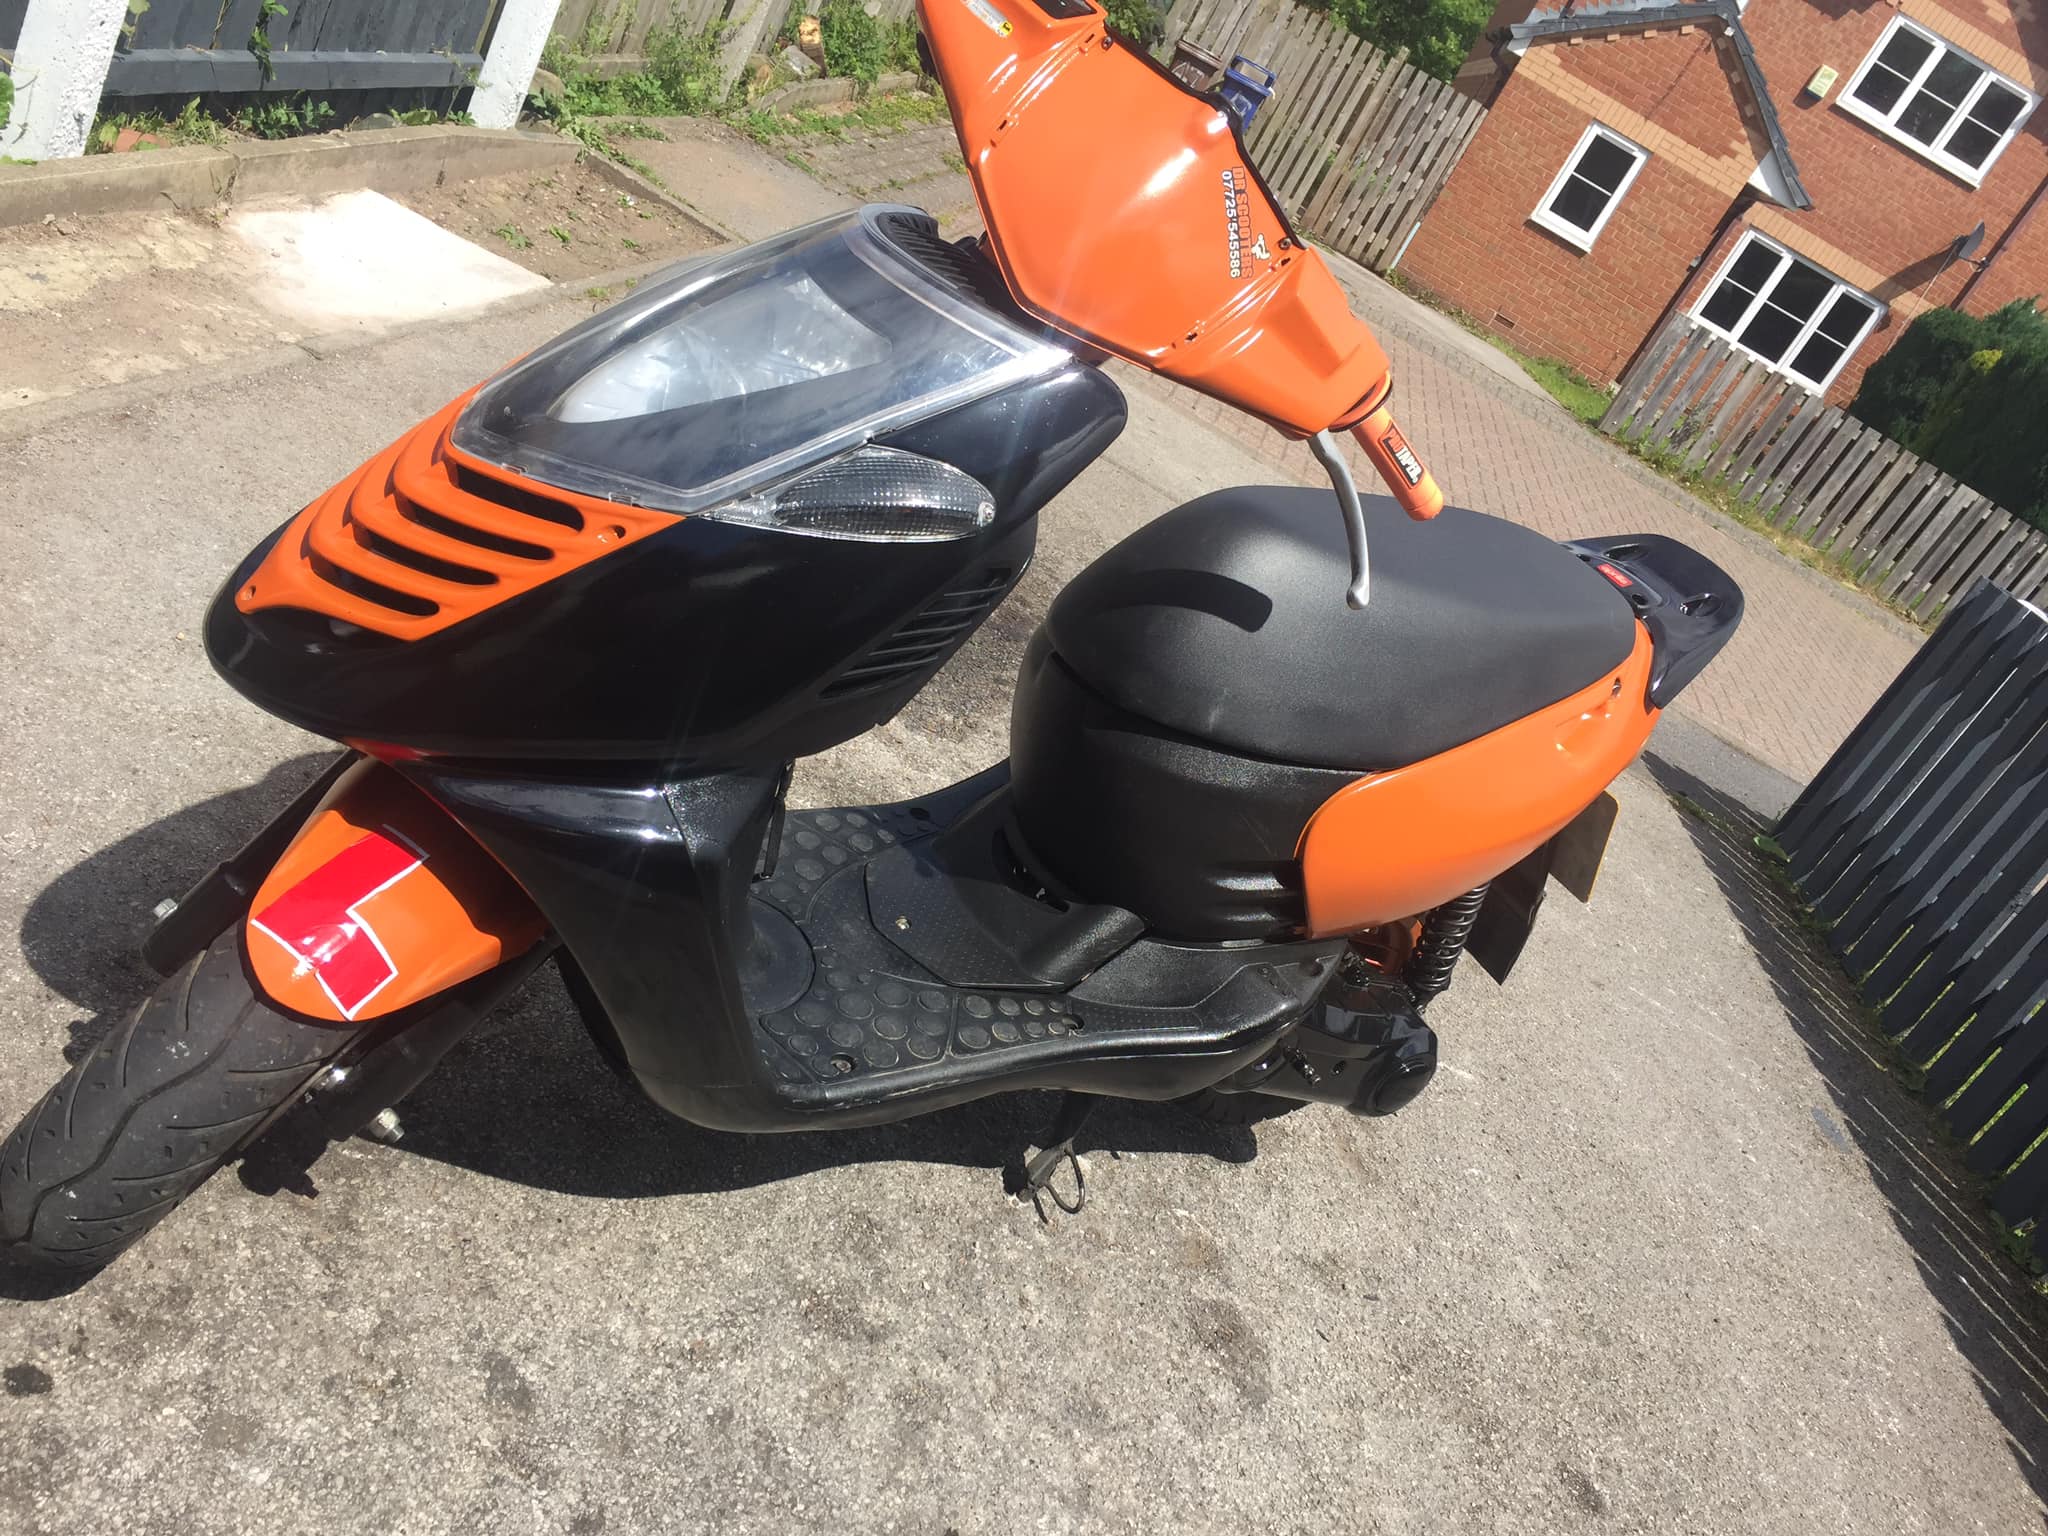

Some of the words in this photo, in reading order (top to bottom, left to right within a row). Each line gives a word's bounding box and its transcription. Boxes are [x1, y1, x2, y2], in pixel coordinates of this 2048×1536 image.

[1232, 167, 1246, 190] DR
[1237, 192, 1254, 279] SCOOTERS
[251, 825, 430, 1021] L
